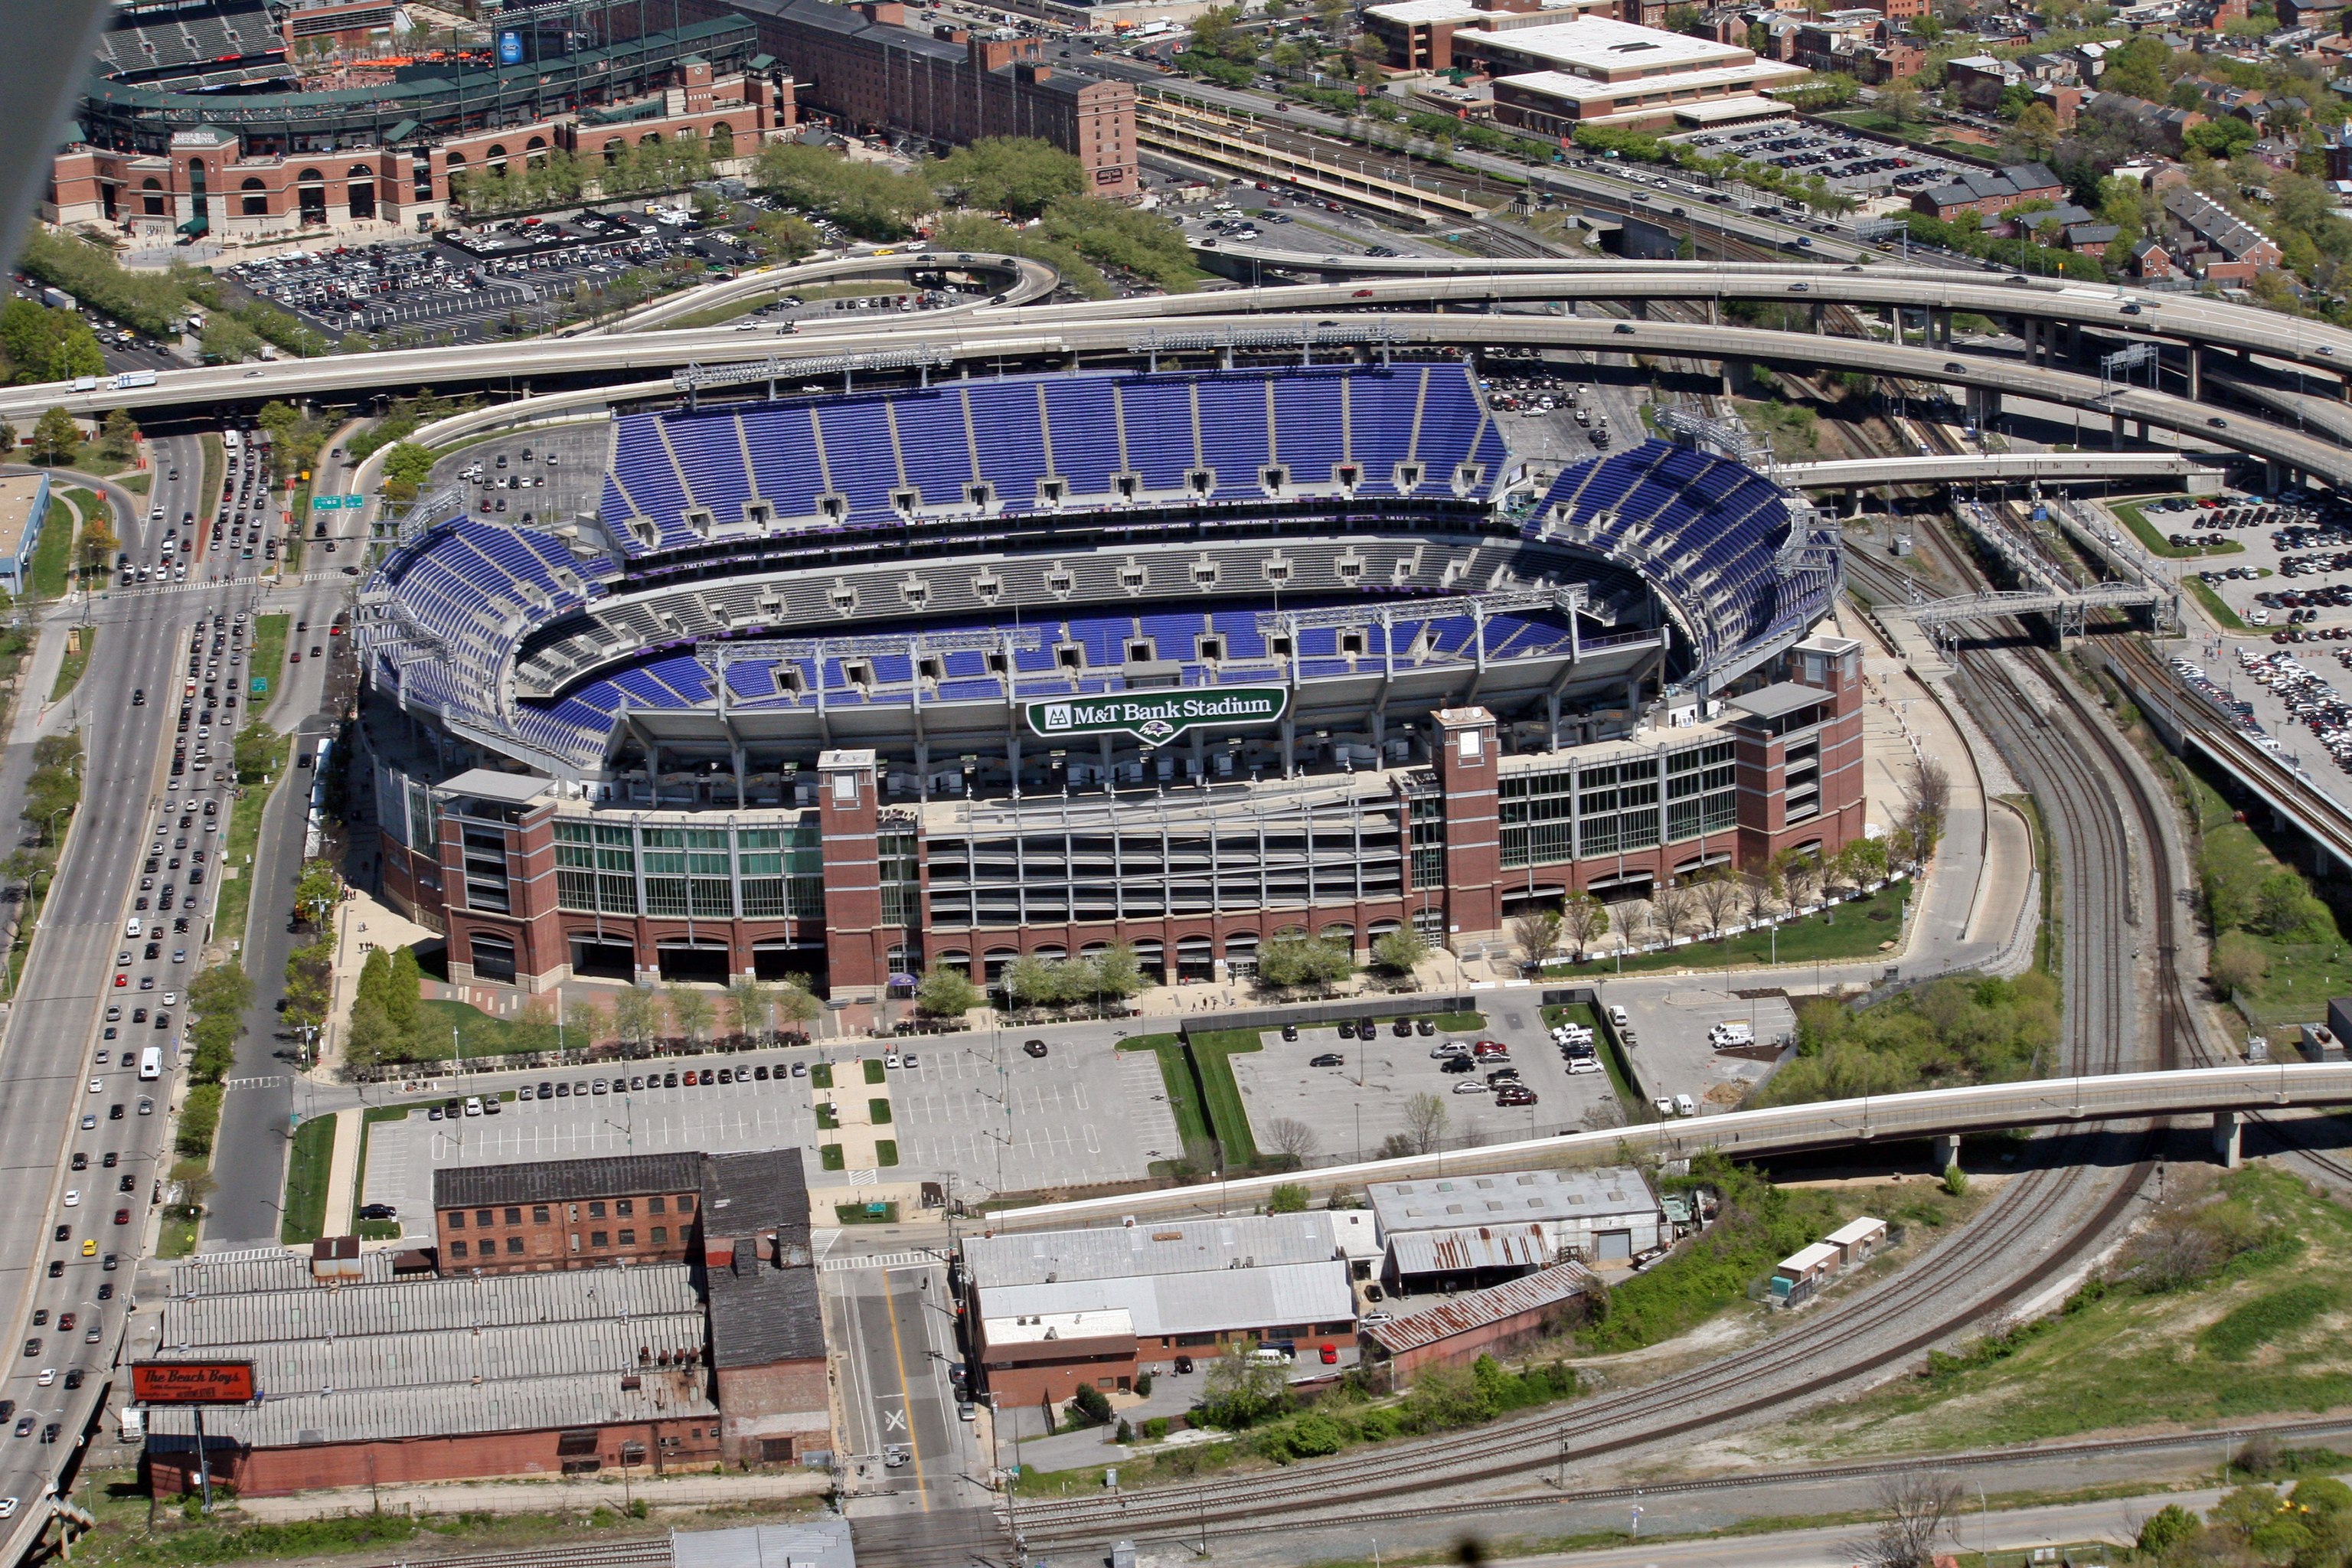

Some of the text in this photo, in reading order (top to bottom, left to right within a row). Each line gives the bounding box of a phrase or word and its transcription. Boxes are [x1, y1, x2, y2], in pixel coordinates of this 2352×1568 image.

[1073, 697, 1272, 725] M&T Bank Stadium
[144, 1369, 240, 1385] The Beach Boys
